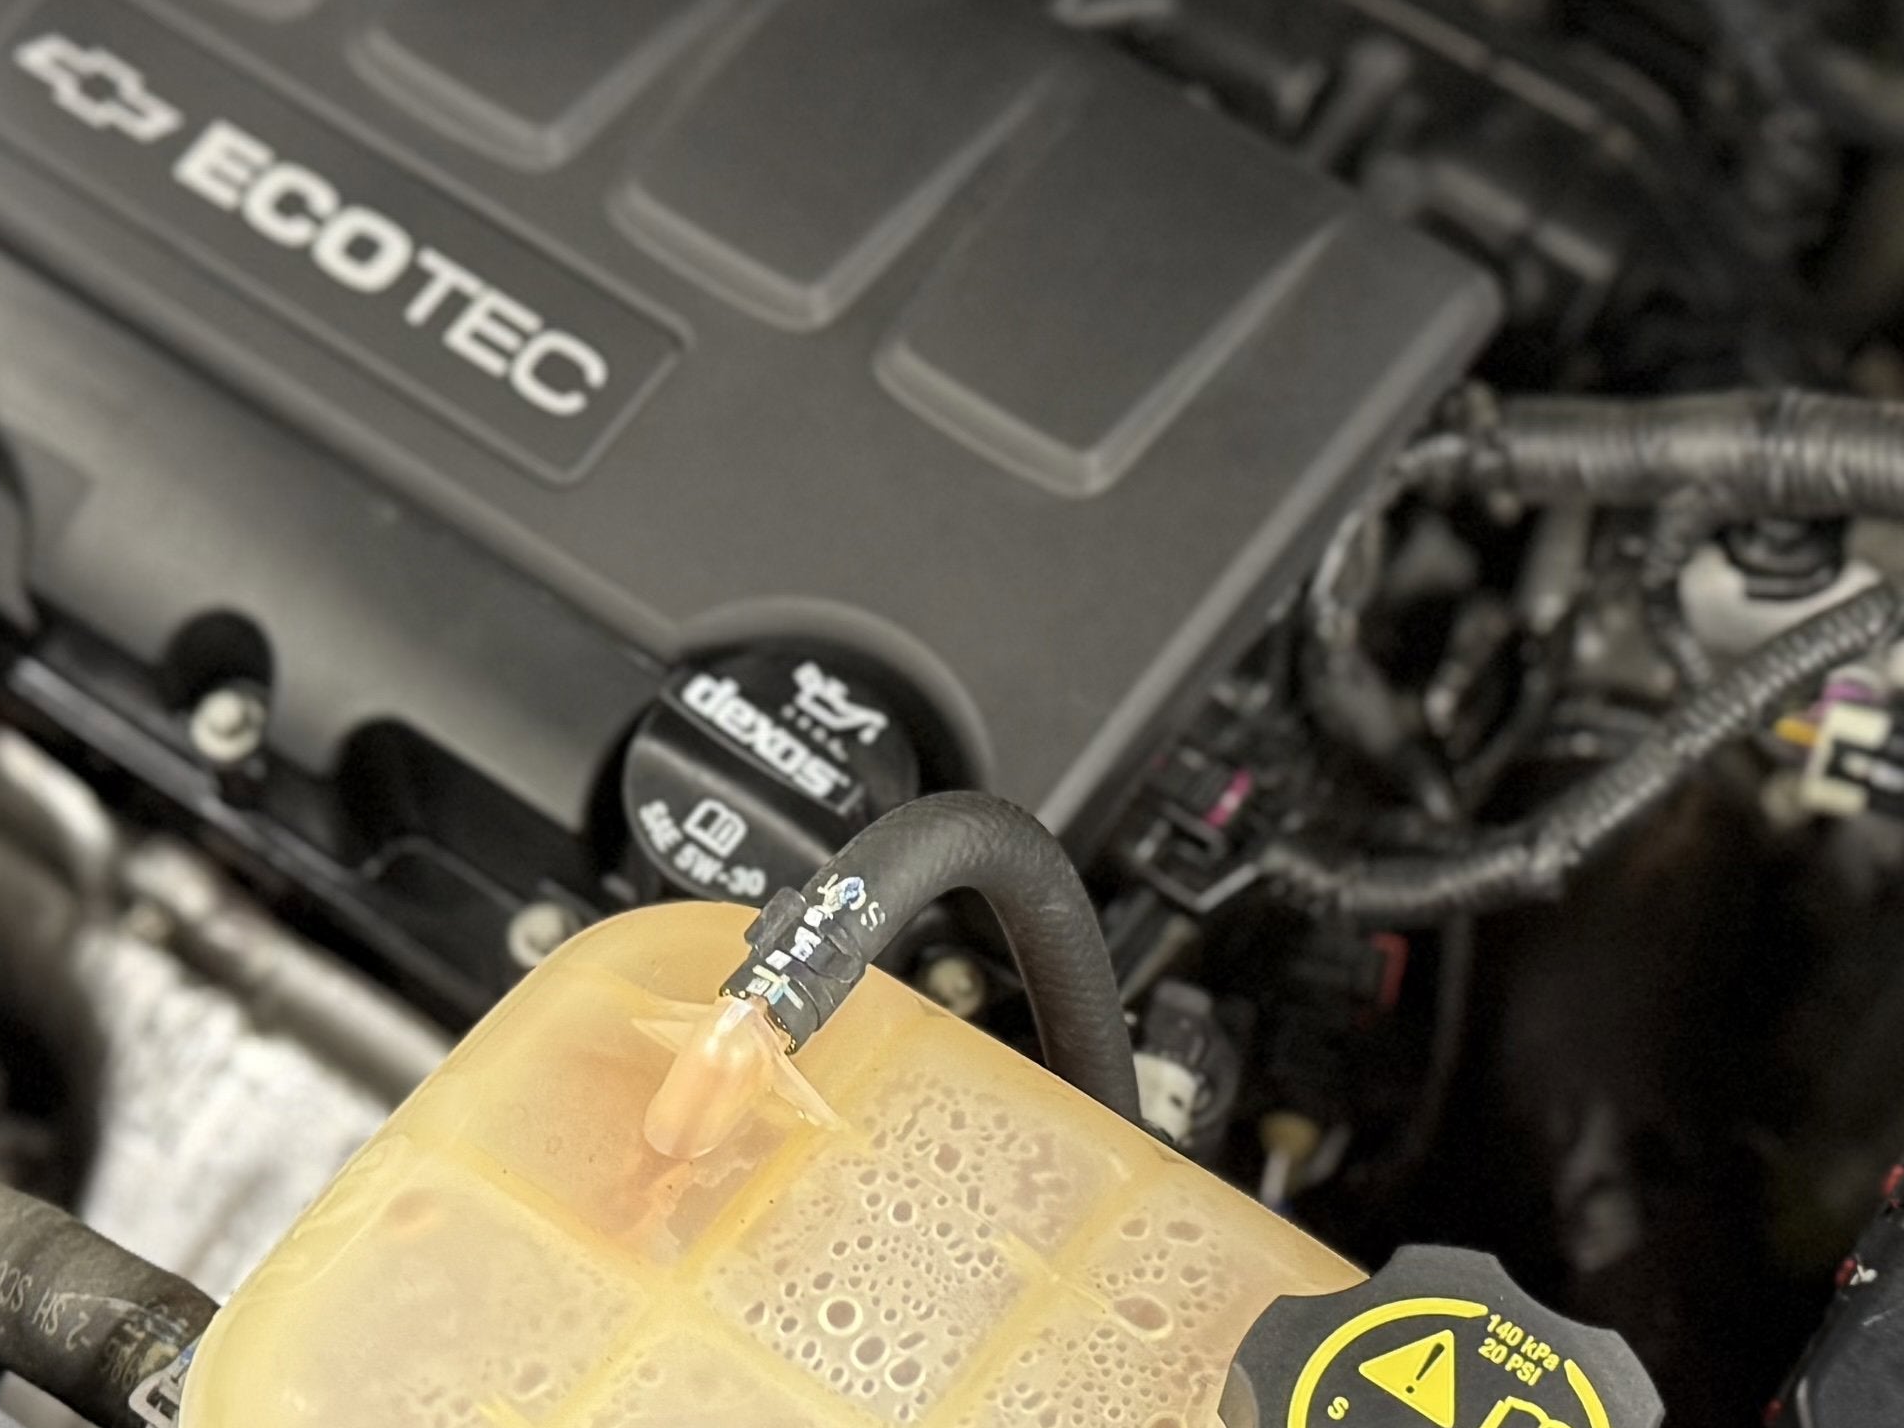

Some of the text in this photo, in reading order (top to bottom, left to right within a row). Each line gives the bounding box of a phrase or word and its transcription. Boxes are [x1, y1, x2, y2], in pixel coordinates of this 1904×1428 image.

[174, 120, 608, 417] ECOTEC
[681, 672, 847, 800] dexos
[637, 800, 768, 897] SAE 5W-30
[1477, 1337, 1545, 1387] 20 PSI
[1485, 1313, 1561, 1372] 140 kPa
[1326, 1395, 1350, 1421] S
